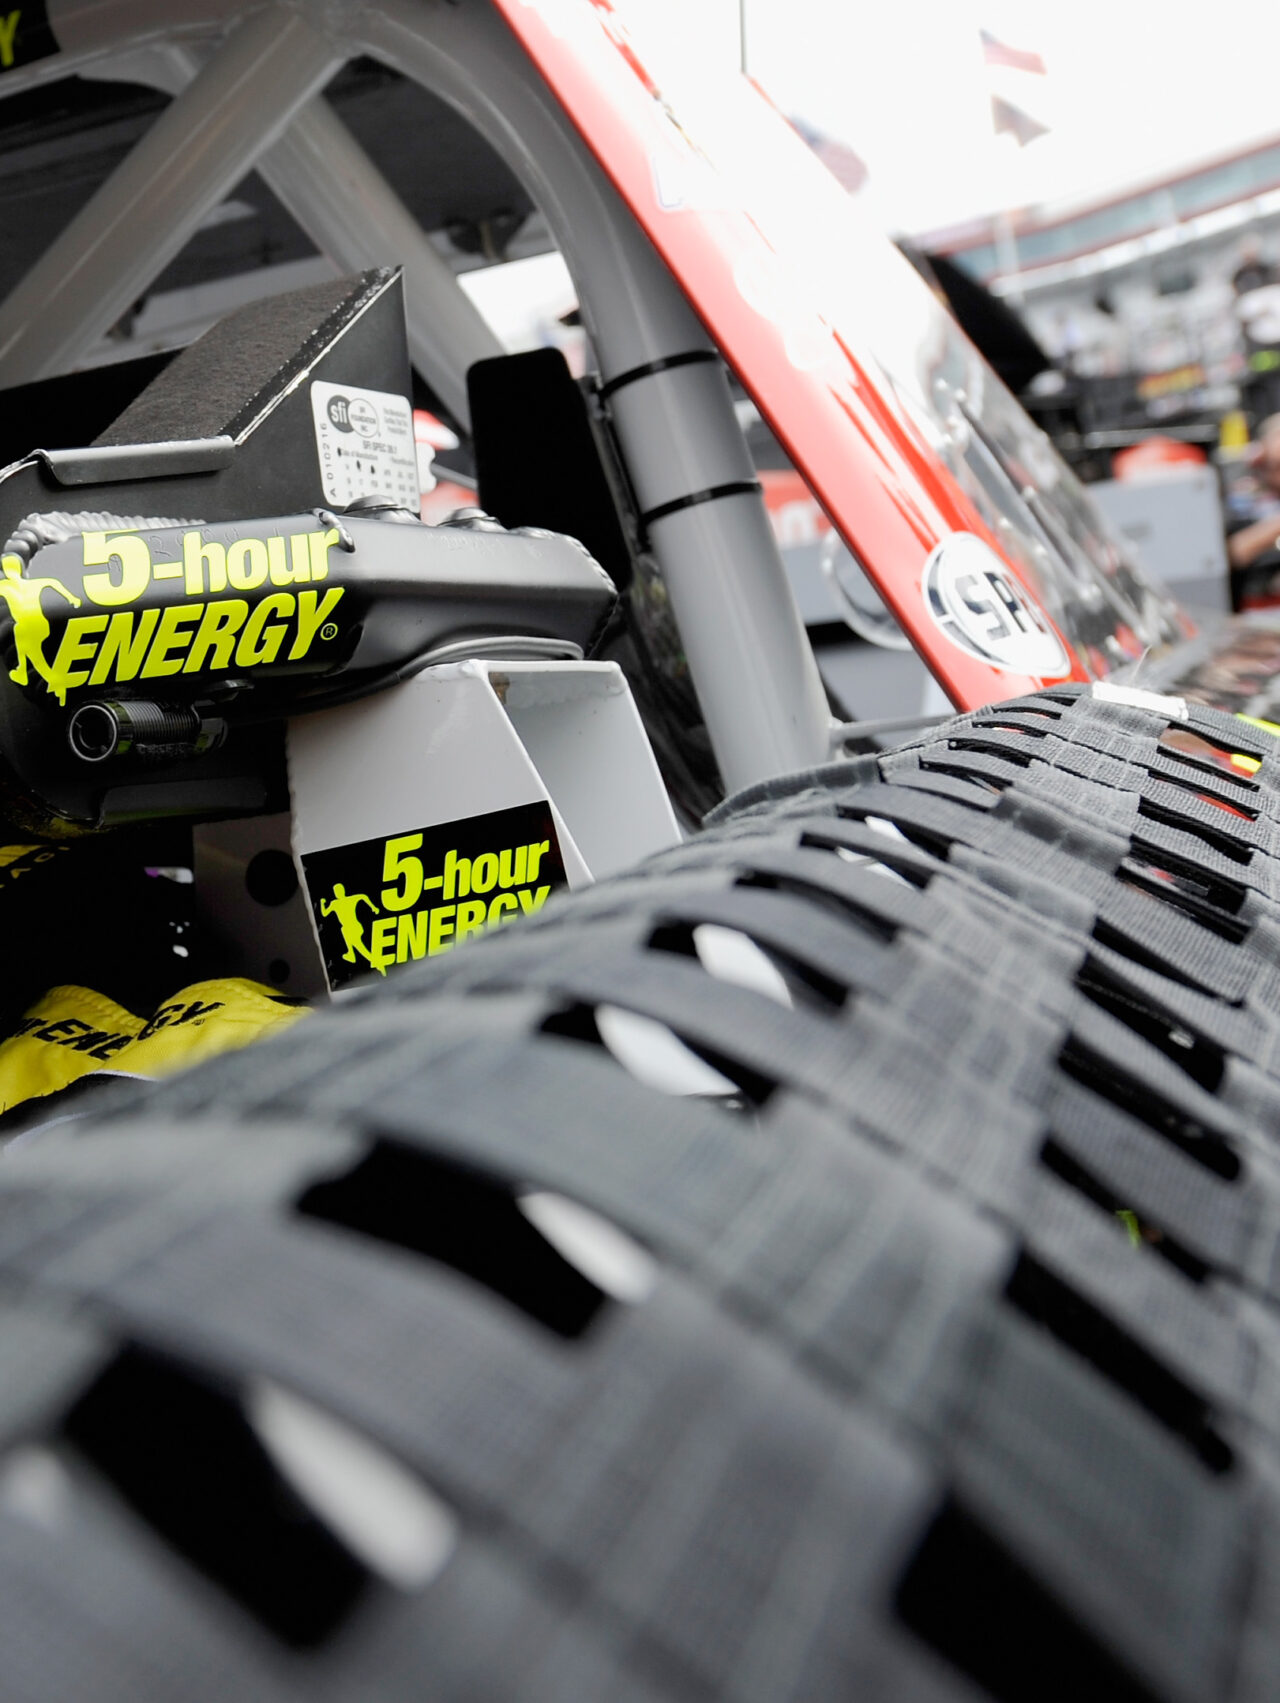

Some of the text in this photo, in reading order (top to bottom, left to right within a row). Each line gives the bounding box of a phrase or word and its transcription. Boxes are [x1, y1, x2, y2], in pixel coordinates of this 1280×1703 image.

[330, 401, 348, 424] sfi
[82, 528, 339, 606] 5-hour
[381, 833, 550, 912] 5-hour
